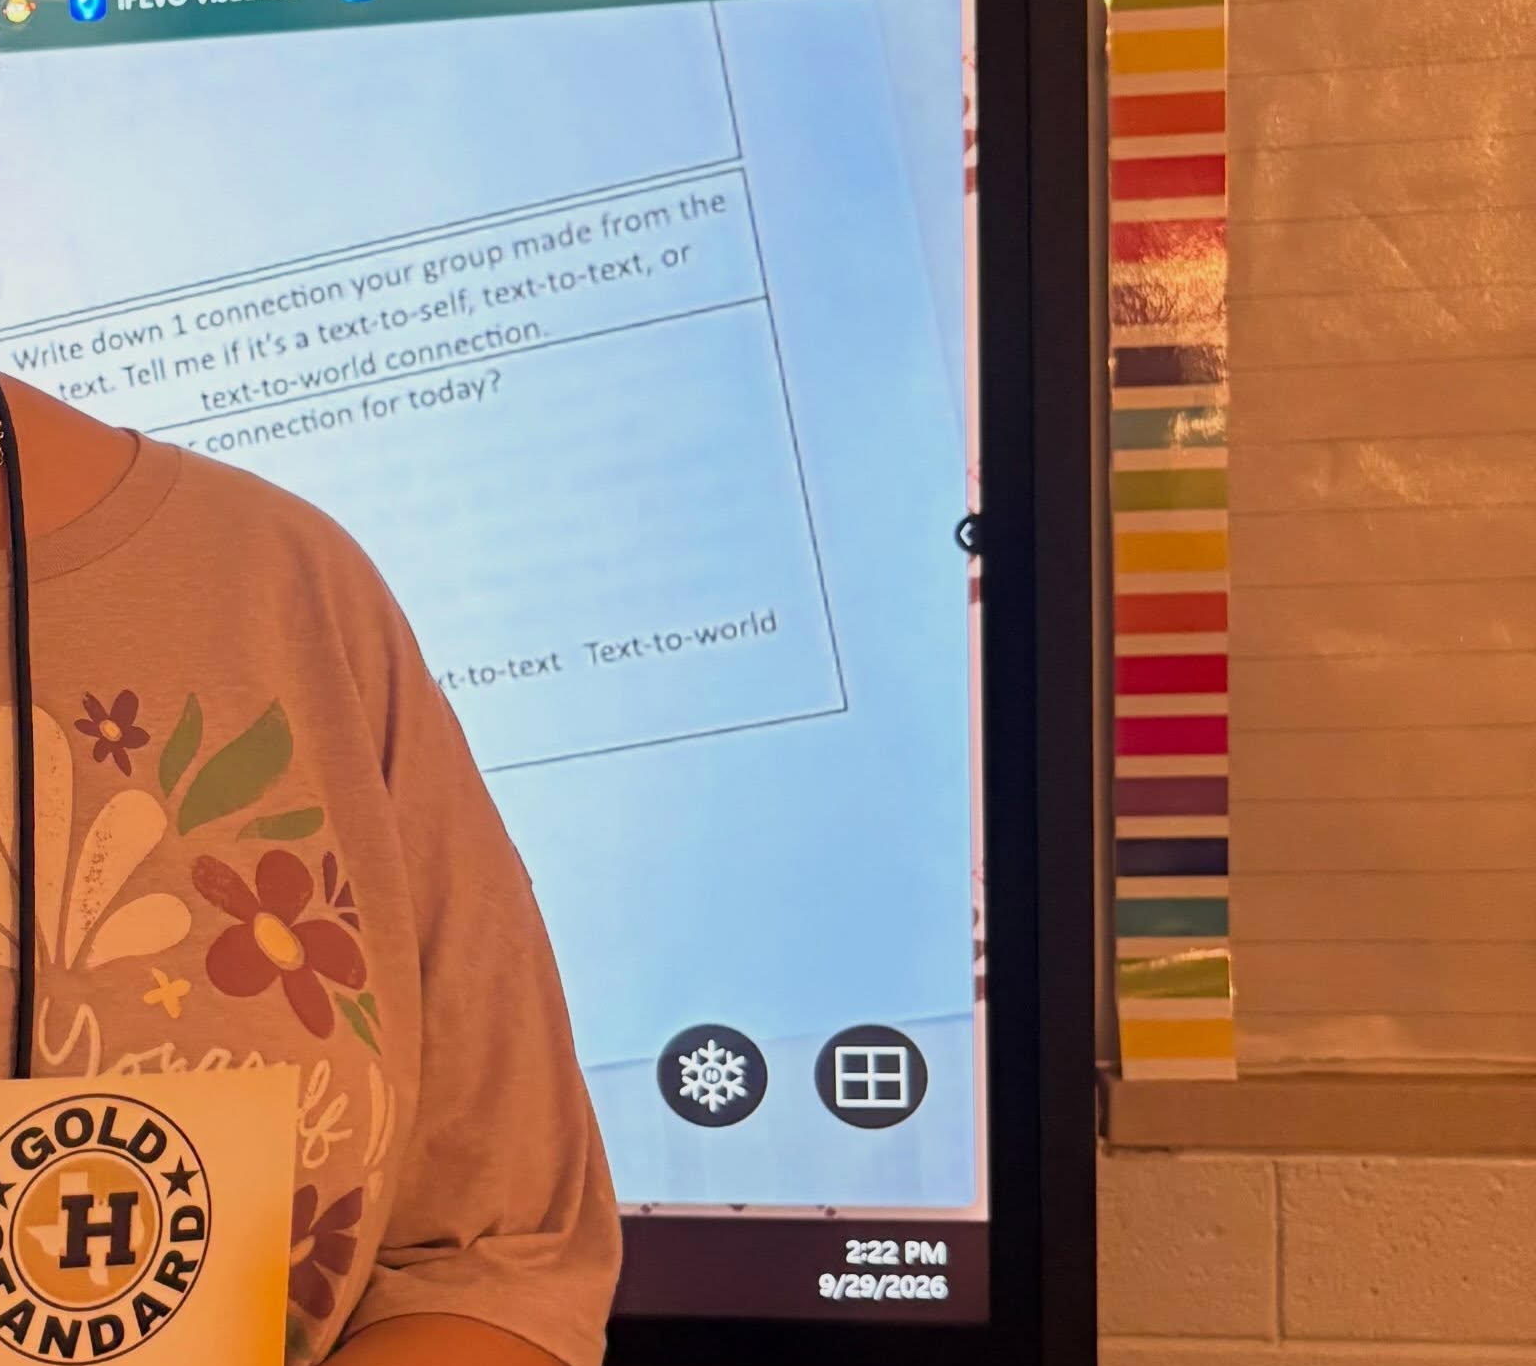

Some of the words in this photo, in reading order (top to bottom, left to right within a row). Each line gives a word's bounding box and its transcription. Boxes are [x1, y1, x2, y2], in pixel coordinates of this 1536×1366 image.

[12, 342, 83, 371] Write
[91, 324, 163, 355] down
[195, 282, 344, 330] connection
[349, 264, 413, 300] your
[422, 245, 503, 284] group
[512, 221, 591, 259] made
[601, 207, 670, 237] from
[679, 194, 725, 220] the
[121, 357, 166, 387] Tell
[248, 332, 287, 360] it's
[317, 288, 474, 344] text-to-self,
[482, 253, 651, 307] text-to-text,
[200, 351, 376, 411] text-to-world
[385, 322, 548, 370] connection.
[205, 407, 352, 453] connection
[361, 395, 400, 420] for
[407, 368, 501, 409] today?
[583, 610, 776, 664] Text-to-world
[9, 1106, 168, 1172] GOLD
[59, 1191, 139, 1269] H
[845, 1239, 899, 1264] 2:22
[819, 1273, 948, 1300] 9/29/2026
